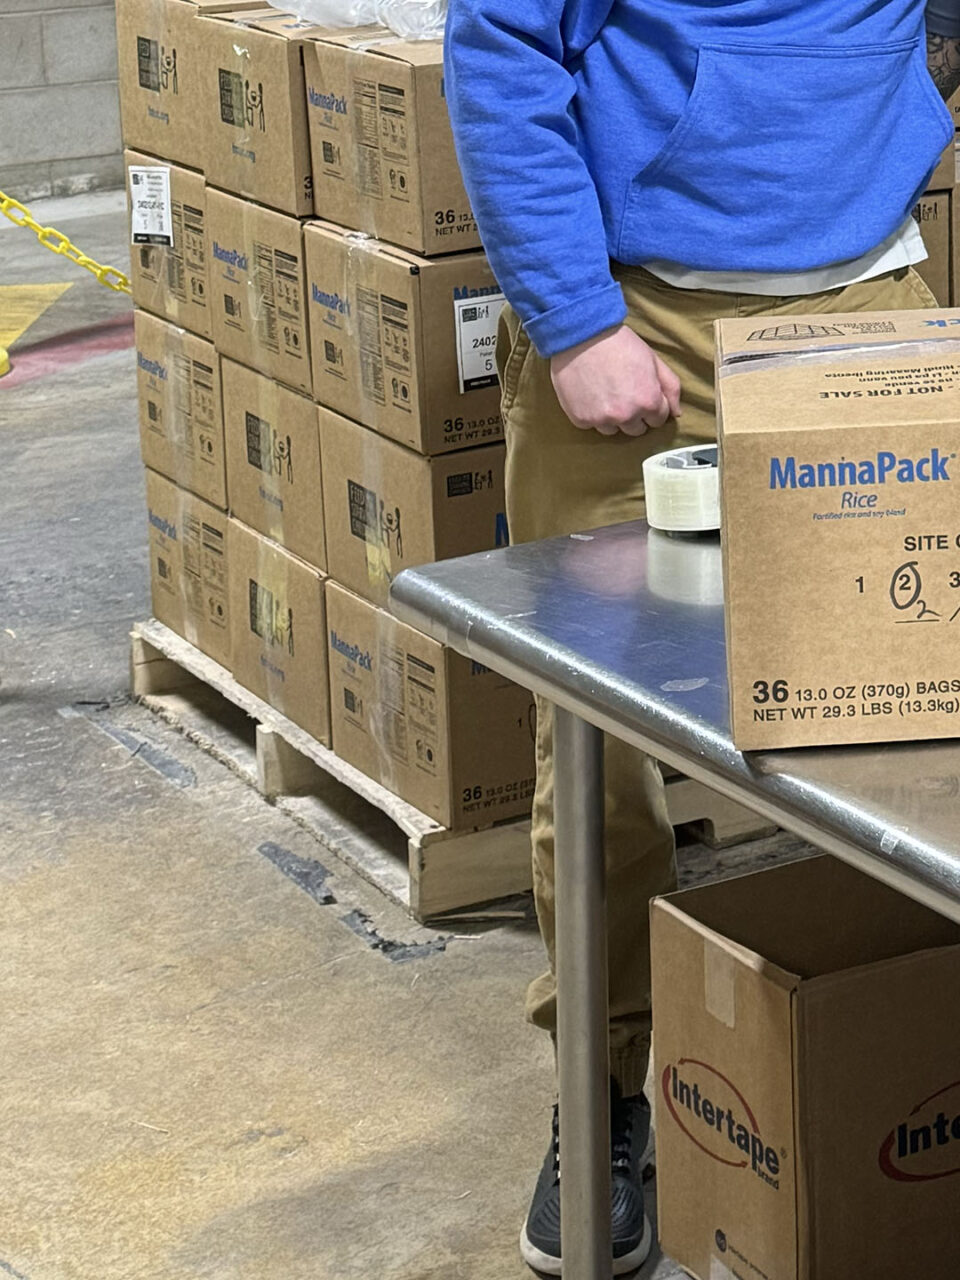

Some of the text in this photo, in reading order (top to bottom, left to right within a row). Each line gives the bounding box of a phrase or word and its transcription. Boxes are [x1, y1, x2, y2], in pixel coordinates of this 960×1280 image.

[435, 209, 456, 225] 36
[435, 223, 472, 236] NET WT
[485, 359, 493, 371] 5
[907, 386, 943, 394] NOT
[443, 417, 464, 433] 36
[769, 448, 951, 489] MannaPack
[841, 491, 878, 509] Rice
[812, 512, 842, 520] Fortified
[903, 535, 949, 552] SITE
[855, 576, 865, 593] 1
[898, 574, 912, 591] 2
[752, 679, 789, 704] 36
[795, 688, 828, 702] 13.0
[832, 685, 857, 700] OZ
[861, 682, 911, 701] (370g)
[753, 697, 960, 722] NET WT 29.3 LBS (13.3kg)
[463, 785, 482, 802] 36
[671, 1066, 780, 1176] Intertape
[756, 1166, 780, 1190] brand
